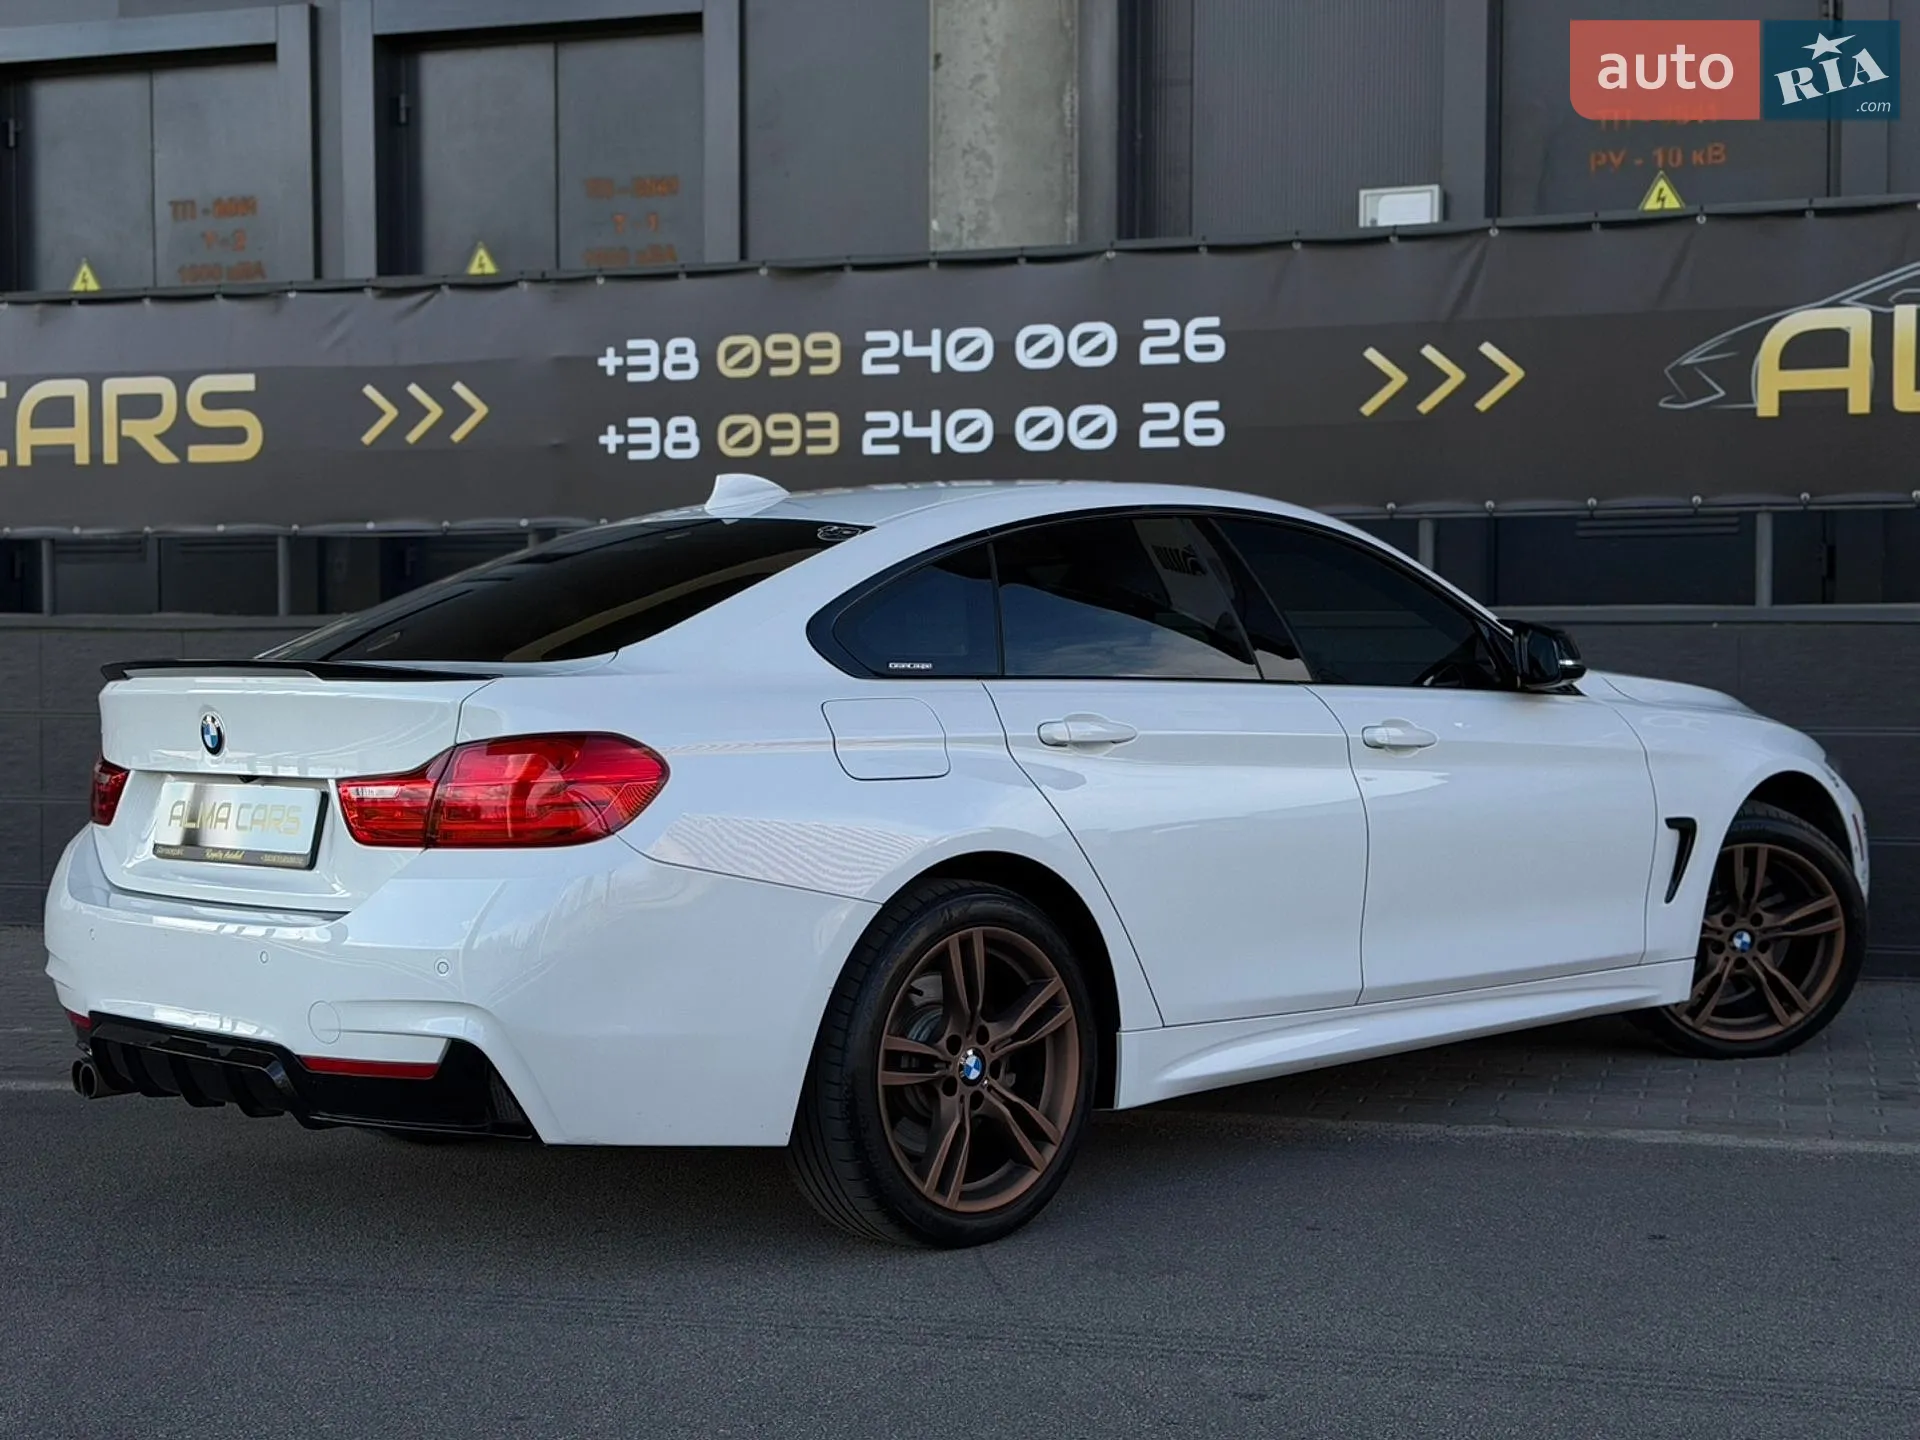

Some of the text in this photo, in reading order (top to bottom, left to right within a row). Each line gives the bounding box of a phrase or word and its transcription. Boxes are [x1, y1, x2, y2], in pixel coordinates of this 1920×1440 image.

[598, 316, 1225, 382] +38 099 240 00 26
[0, 374, 262, 466] ARS
[599, 401, 1225, 460] +38 093 240 00 26
[235, 803, 302, 835] CARS
